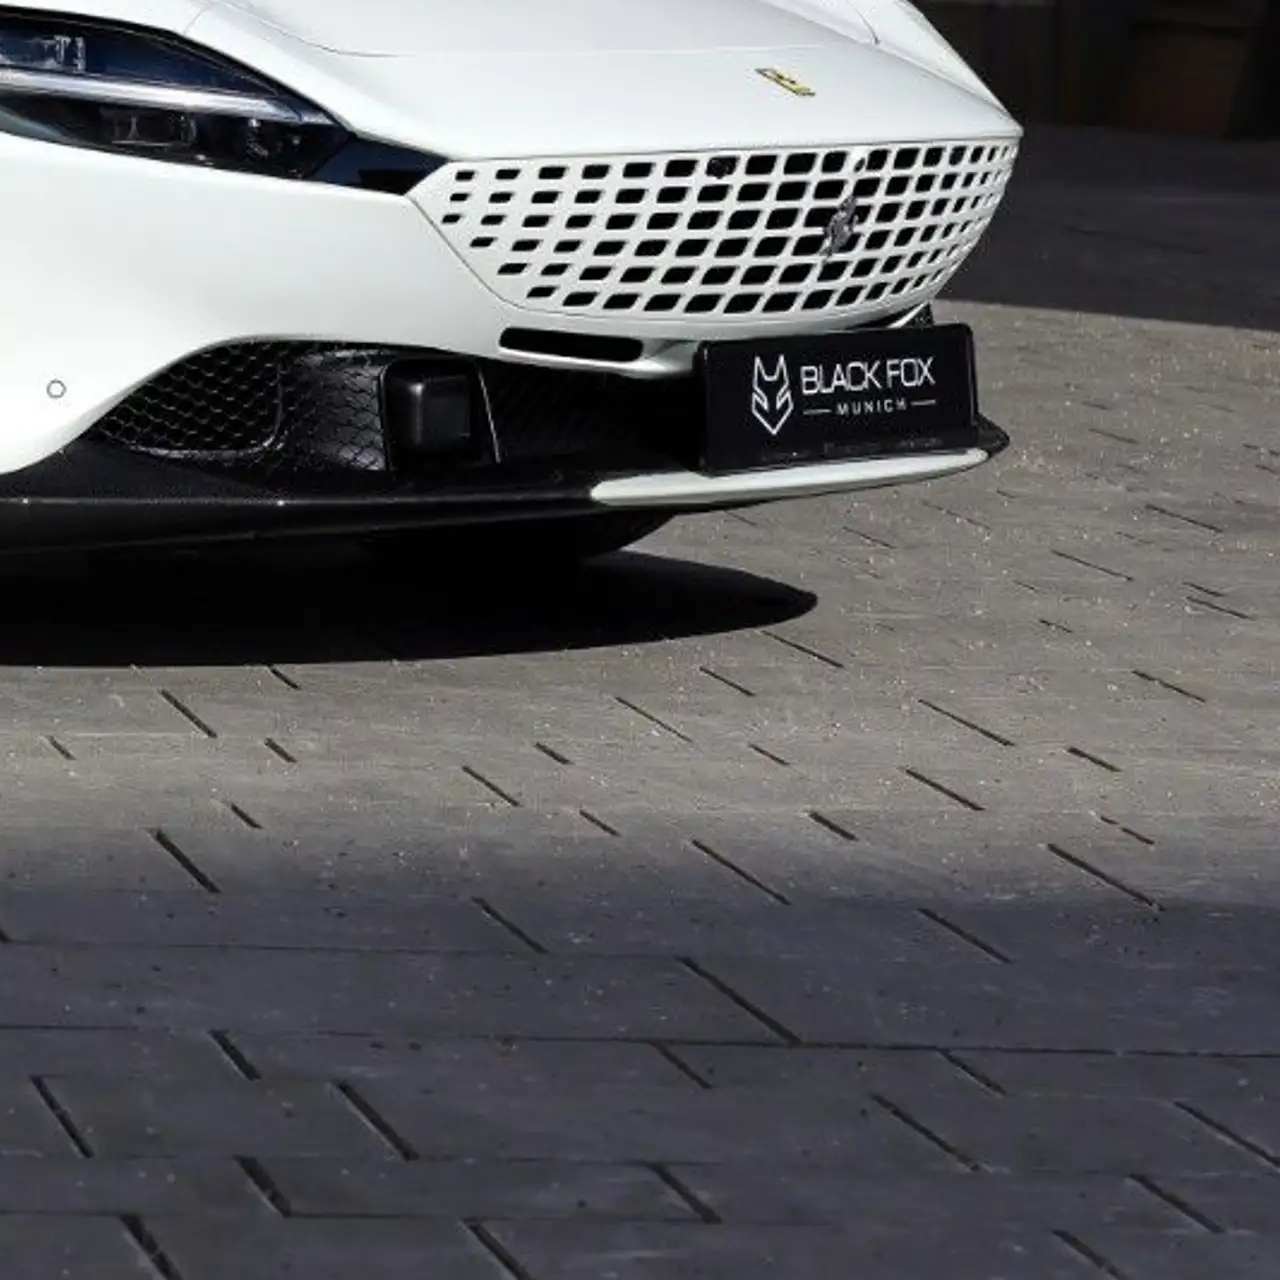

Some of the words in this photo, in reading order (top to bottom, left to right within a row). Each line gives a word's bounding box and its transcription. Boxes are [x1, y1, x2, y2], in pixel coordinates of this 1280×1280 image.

[800, 360, 881, 395] BLACK
[886, 357, 936, 389] FOX
[836, 398, 907, 416] MUNICH
